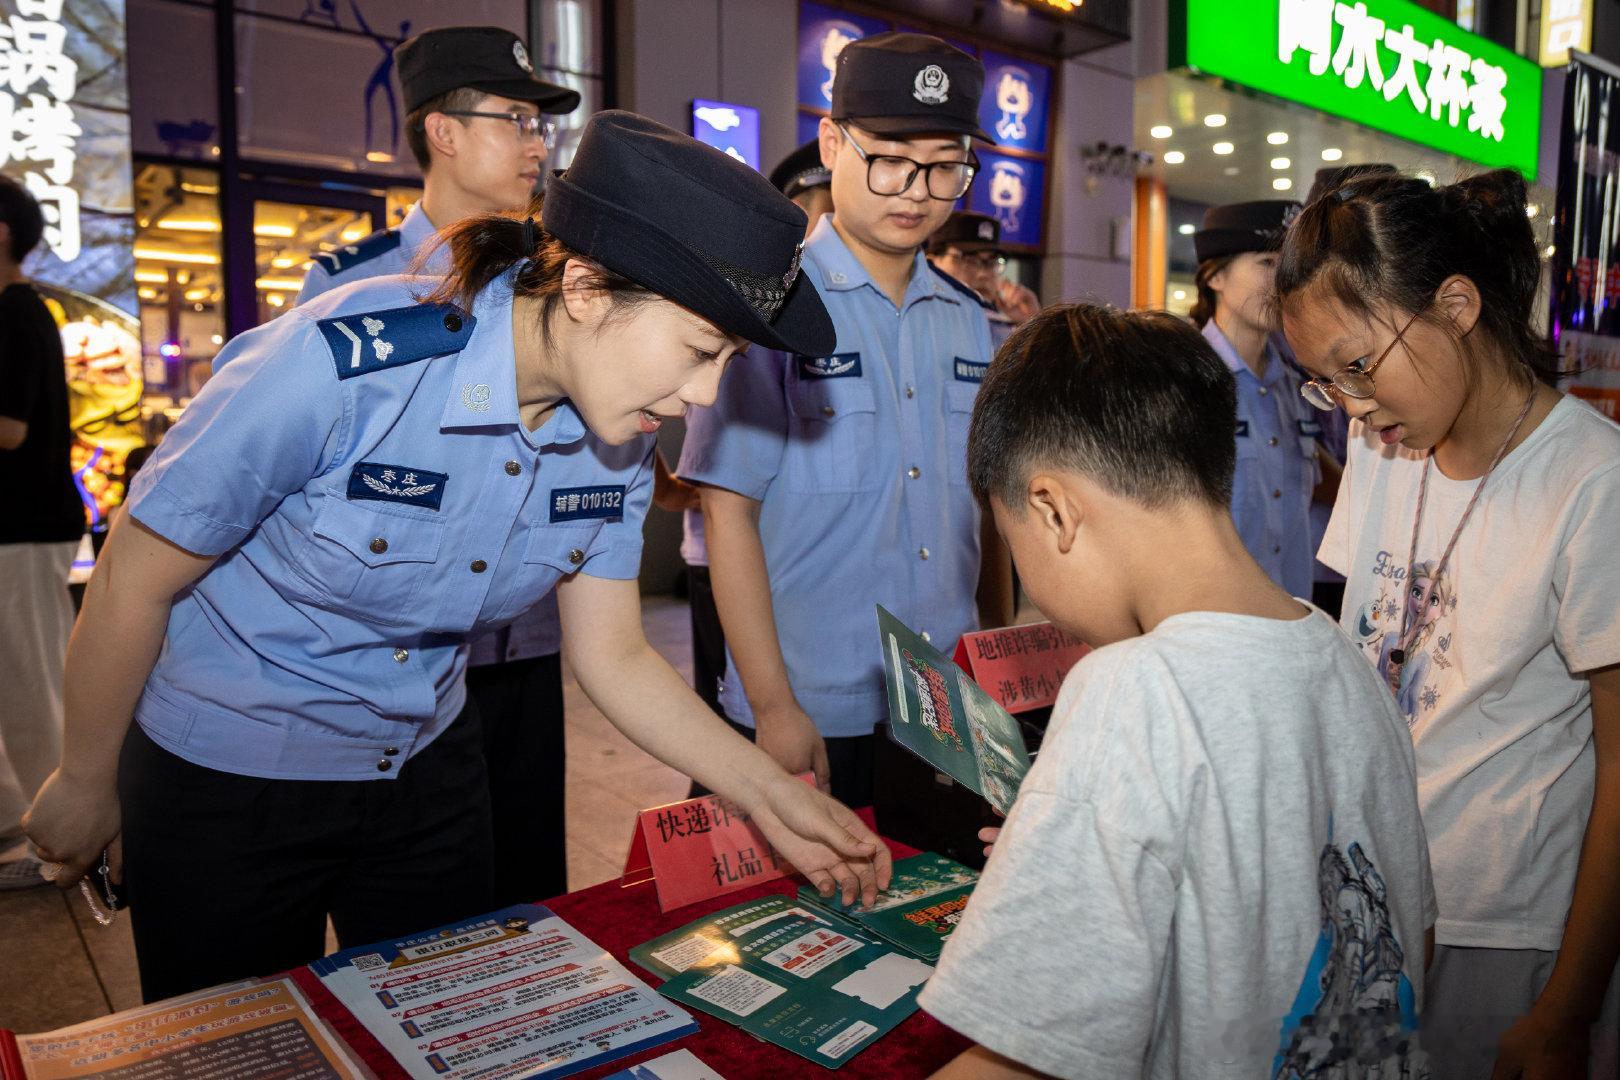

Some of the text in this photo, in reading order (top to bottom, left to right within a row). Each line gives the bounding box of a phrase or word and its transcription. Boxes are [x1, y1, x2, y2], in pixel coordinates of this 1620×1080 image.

[381, 469, 418, 486] 枣庄
[656, 800, 752, 843] 快递诈
[414, 929, 499, 955] 银行取现三问
